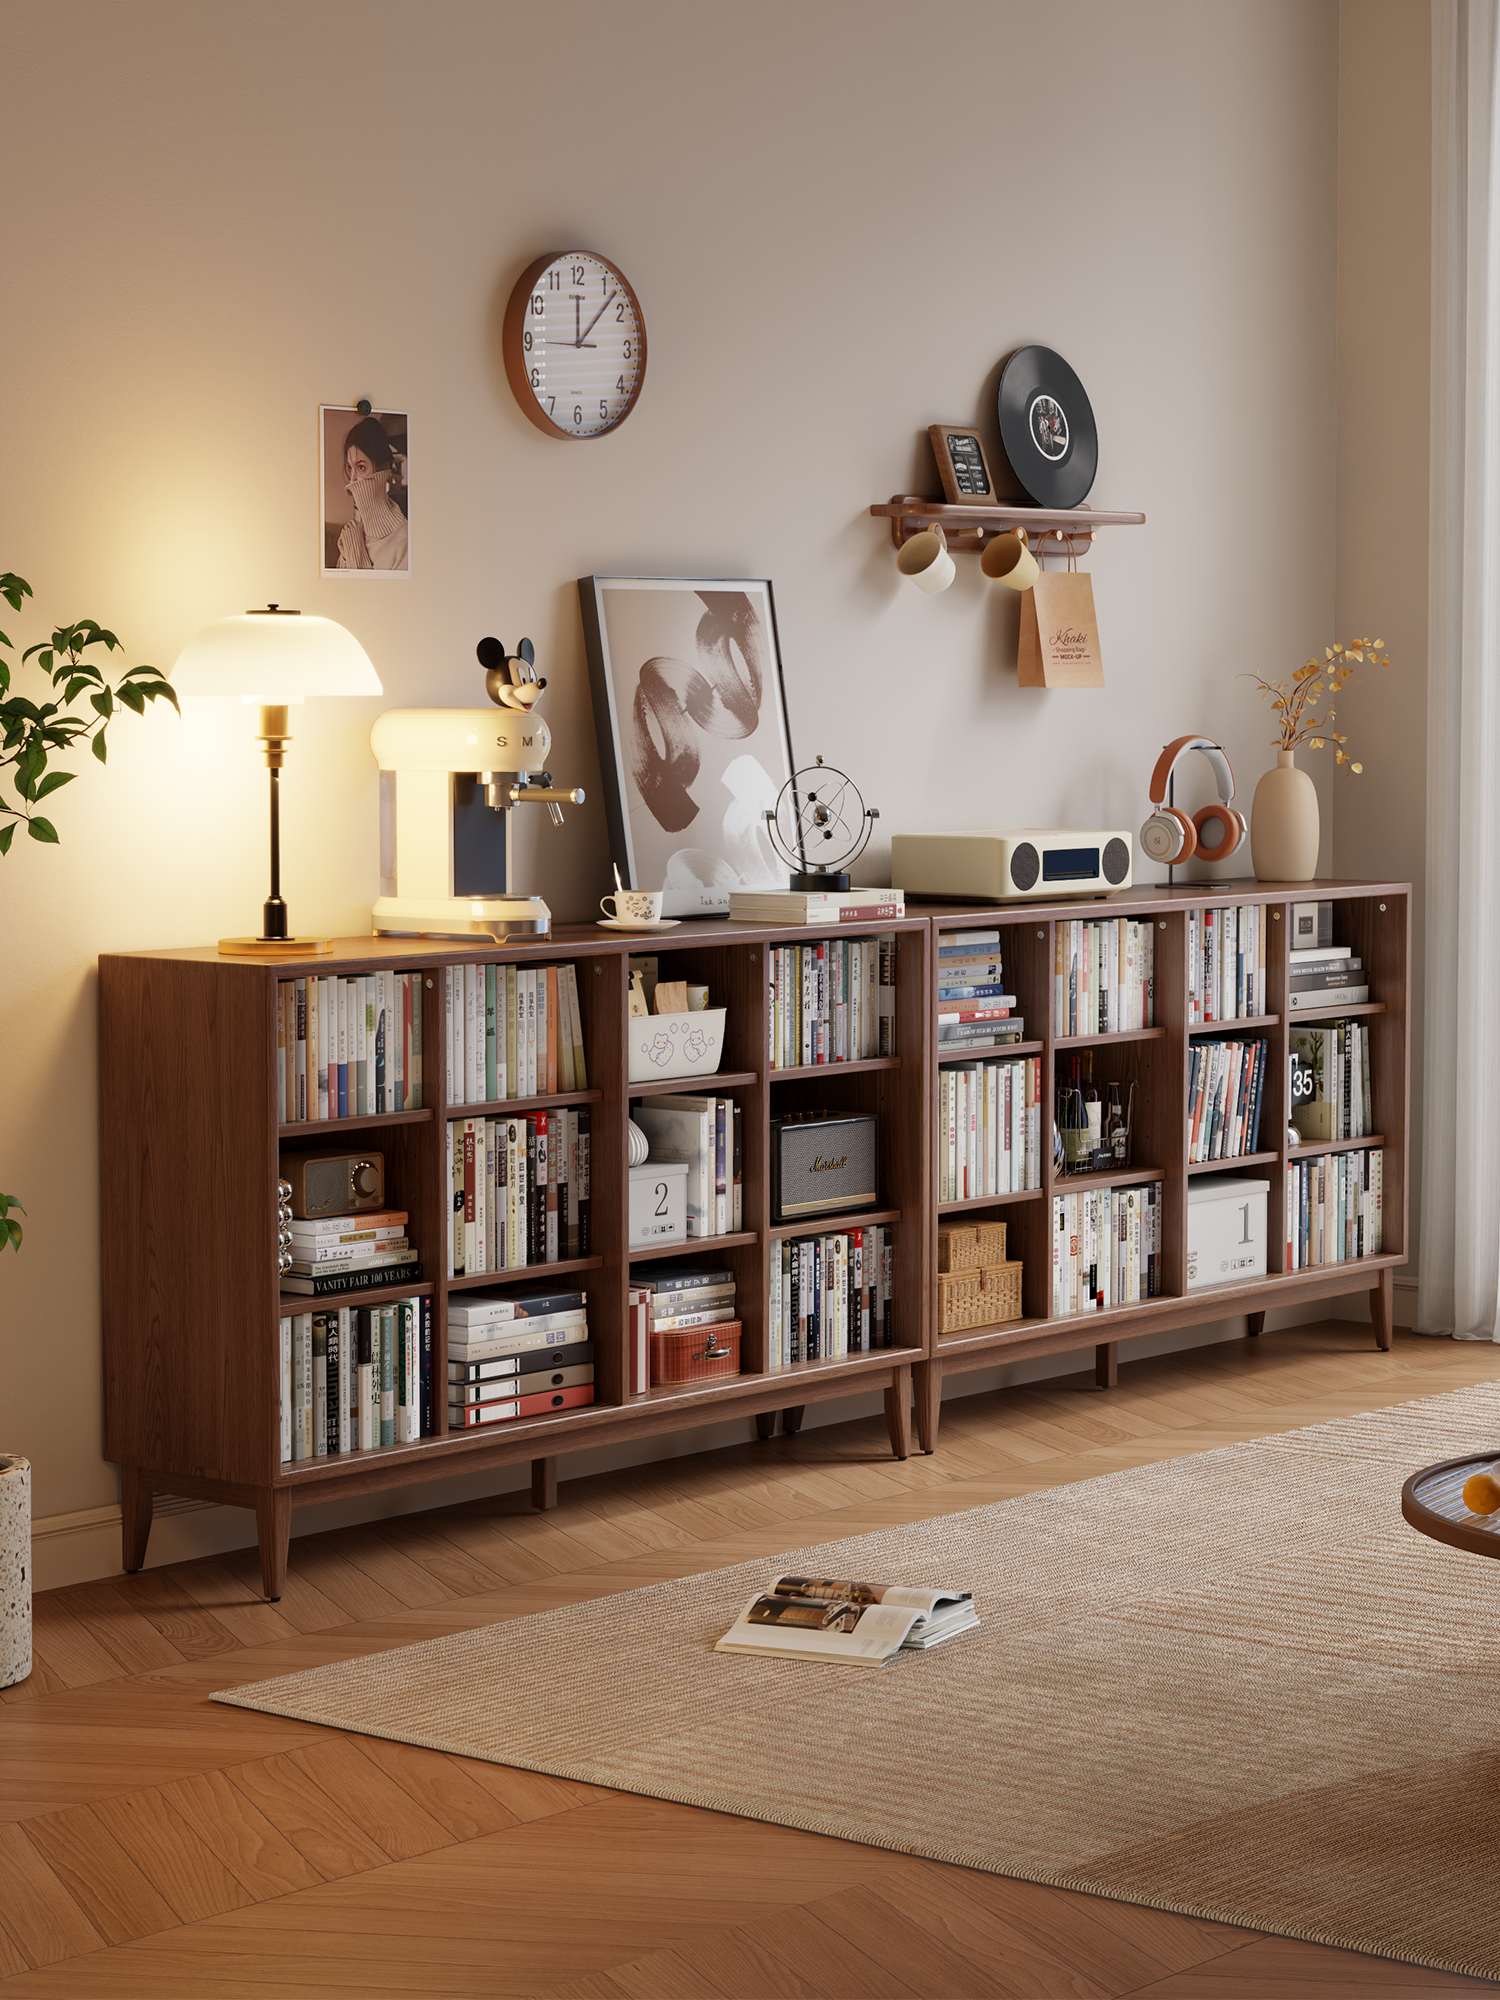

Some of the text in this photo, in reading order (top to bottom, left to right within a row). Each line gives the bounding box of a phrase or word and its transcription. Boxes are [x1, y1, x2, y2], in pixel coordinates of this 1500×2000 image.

[548, 270, 560, 291] 11
[570, 265, 585, 286] 12
[601, 275, 607, 296] 1
[530, 295, 544, 316] 10
[616, 303, 625, 323] 2
[524, 331, 533, 352] 9
[623, 339, 632, 360] 3
[531, 367, 541, 388] 8
[616, 374, 625, 395] 4
[547, 395, 556, 416] 7
[573, 404, 582, 425] 6
[599, 399, 608, 420] 5
[1049, 628, 1088, 646] Khaki
[700, 896, 714, 906] Ink
[1293, 1069, 1313, 1097] 35
[548, 1122, 556, 1194] 经济学原理
[810, 1155, 848, 1173] Marshall
[654, 1182, 668, 1217] 2
[1238, 1203, 1254, 1244] 1
[368, 1258, 383, 1267] JASPER
[383, 1257, 398, 1265] JOHNS
[316, 1269, 411, 1292] VANITY FAIR 100 YEARS
[328, 1320, 338, 1362] 後人類時代
[350, 1320, 358, 1375] 狂人日记
[371, 1350, 381, 1407] 儒林外史
